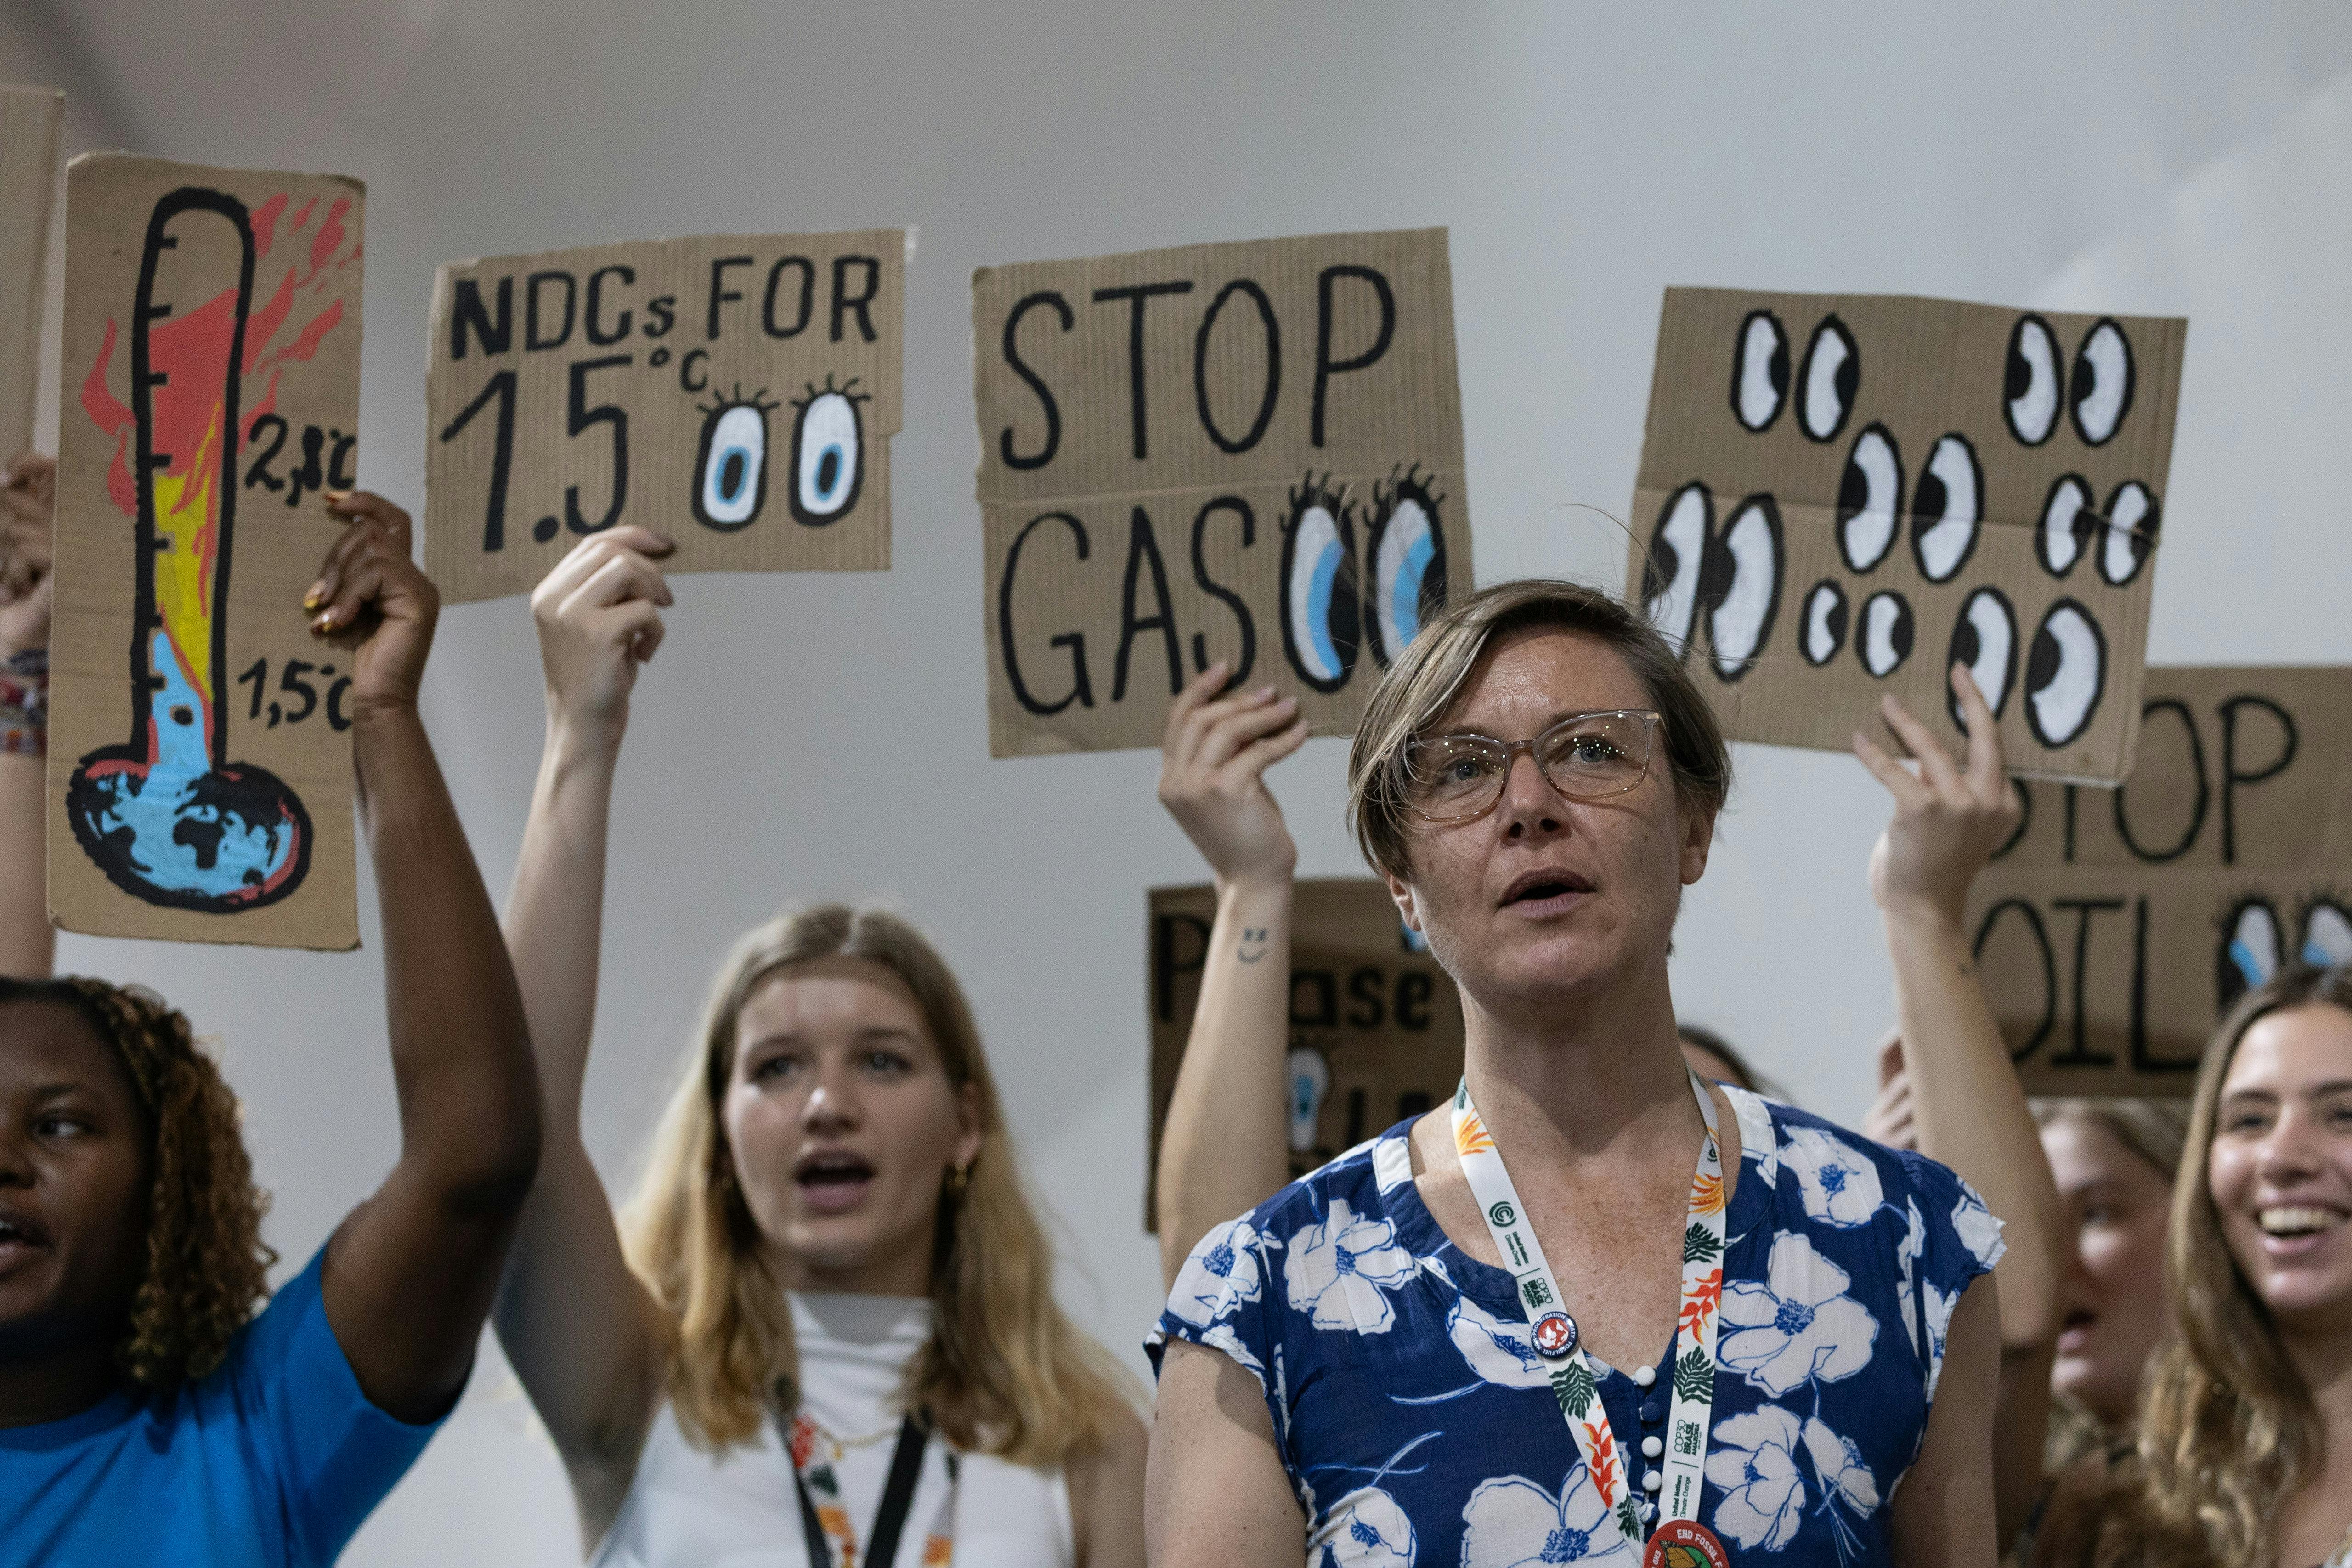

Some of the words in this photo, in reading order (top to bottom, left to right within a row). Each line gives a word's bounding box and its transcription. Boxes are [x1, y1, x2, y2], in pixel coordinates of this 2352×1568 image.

[450, 265, 677, 361] NDCs
[707, 254, 880, 343] FOR
[1000, 264, 1396, 470] STOP
[999, 496, 1256, 717] GAS
[1157, 913, 1433, 1032] Pase
[1505, 1234, 1515, 1251] Climate
[1512, 1250, 1521, 1266] Change
[1512, 1231, 1523, 1246] United
[1519, 1245, 1529, 1264] Nations
[1528, 1279, 1544, 1307] BRASIL
[1536, 1278, 1553, 1303] COP30
[1555, 1341, 1572, 1355] FOSSIL
[1674, 1419, 1686, 1452] COP30
[1683, 1422, 1694, 1455] BRASIL
[1674, 1474, 1682, 1497] Nations
[1682, 1476, 1691, 1497] Change
[1676, 1528, 1693, 1540] END
[1694, 1533, 1718, 1561] FOSSIL
